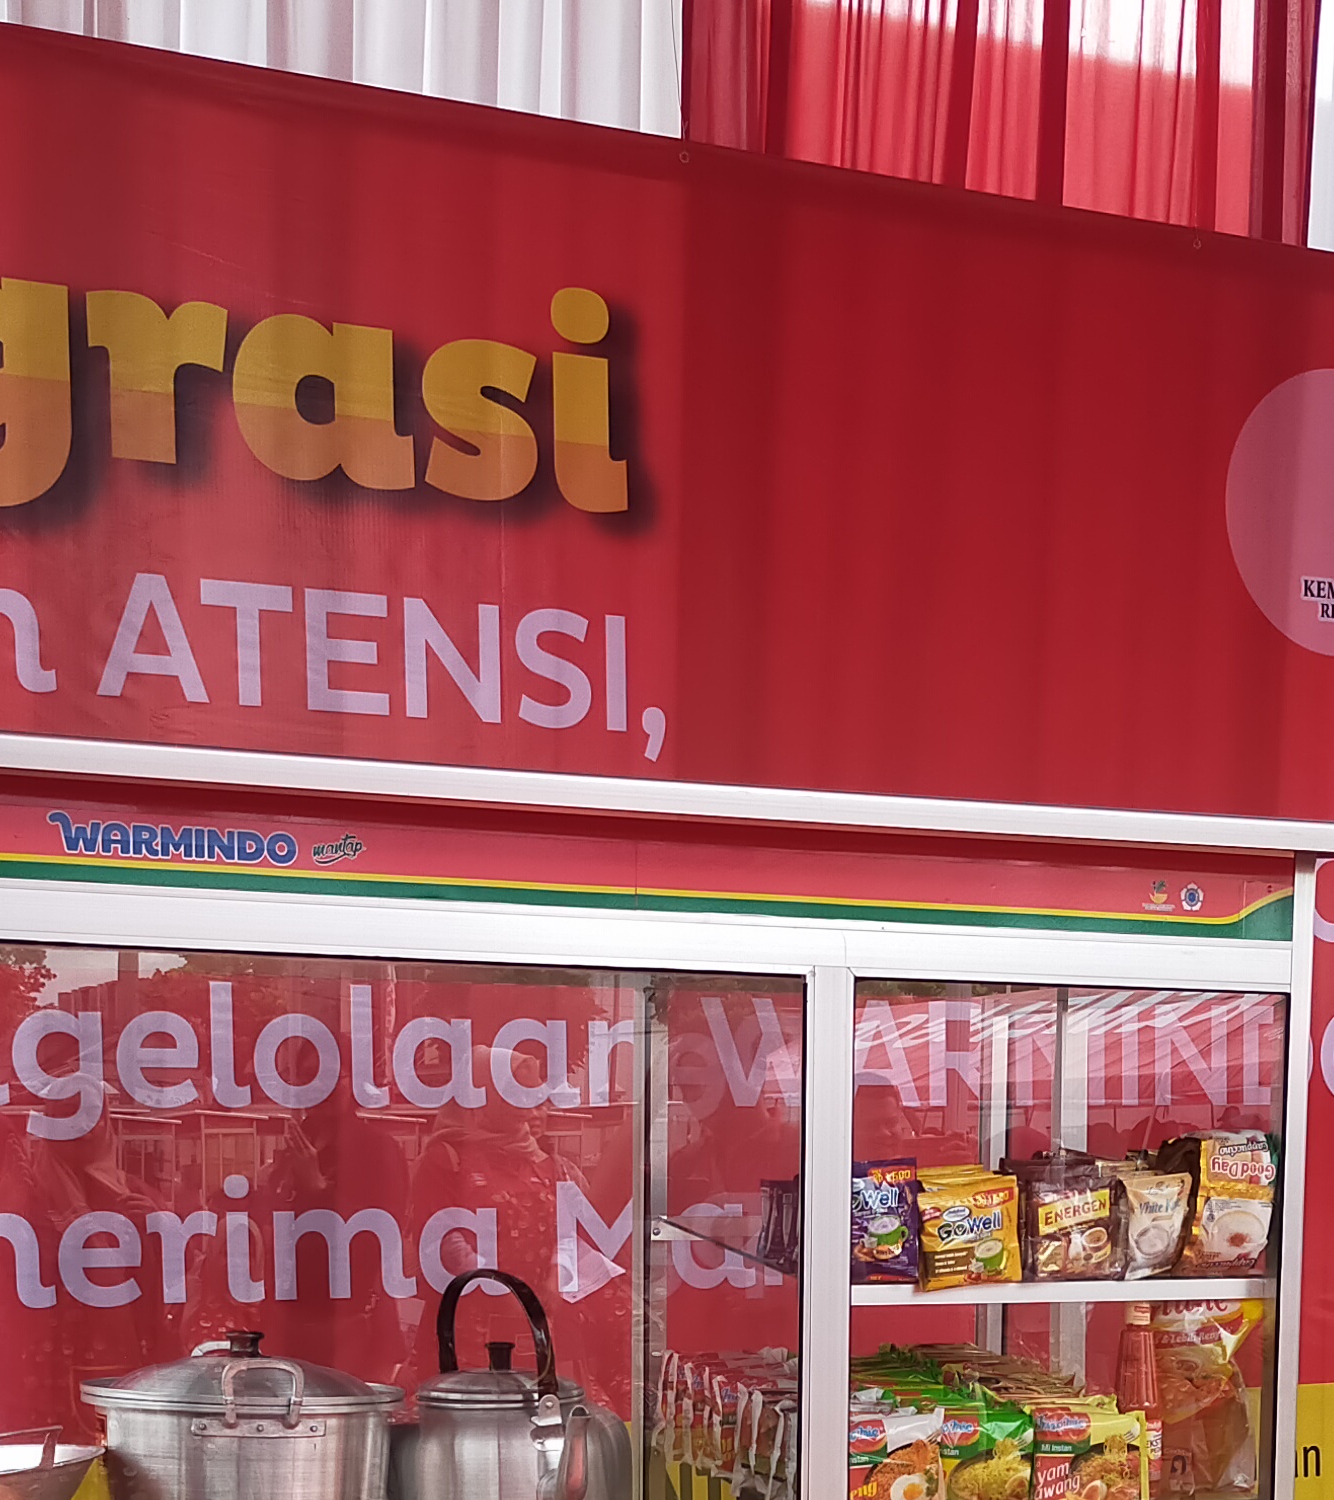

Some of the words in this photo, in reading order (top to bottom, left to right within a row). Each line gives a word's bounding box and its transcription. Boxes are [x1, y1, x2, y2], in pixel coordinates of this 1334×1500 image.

[96, 572, 667, 763] ATENSI,
[47, 810, 298, 866] WARMINDO
[312, 831, 367, 866] mantap
[1211, 1156, 1239, 1177] Day
[1240, 1163, 1276, 1181] Good
[1044, 1199, 1108, 1227] ENERGEN
[1041, 1444, 1051, 1452] Mi
[1035, 1475, 1081, 1500] awang
[1037, 1462, 1070, 1488] yam
